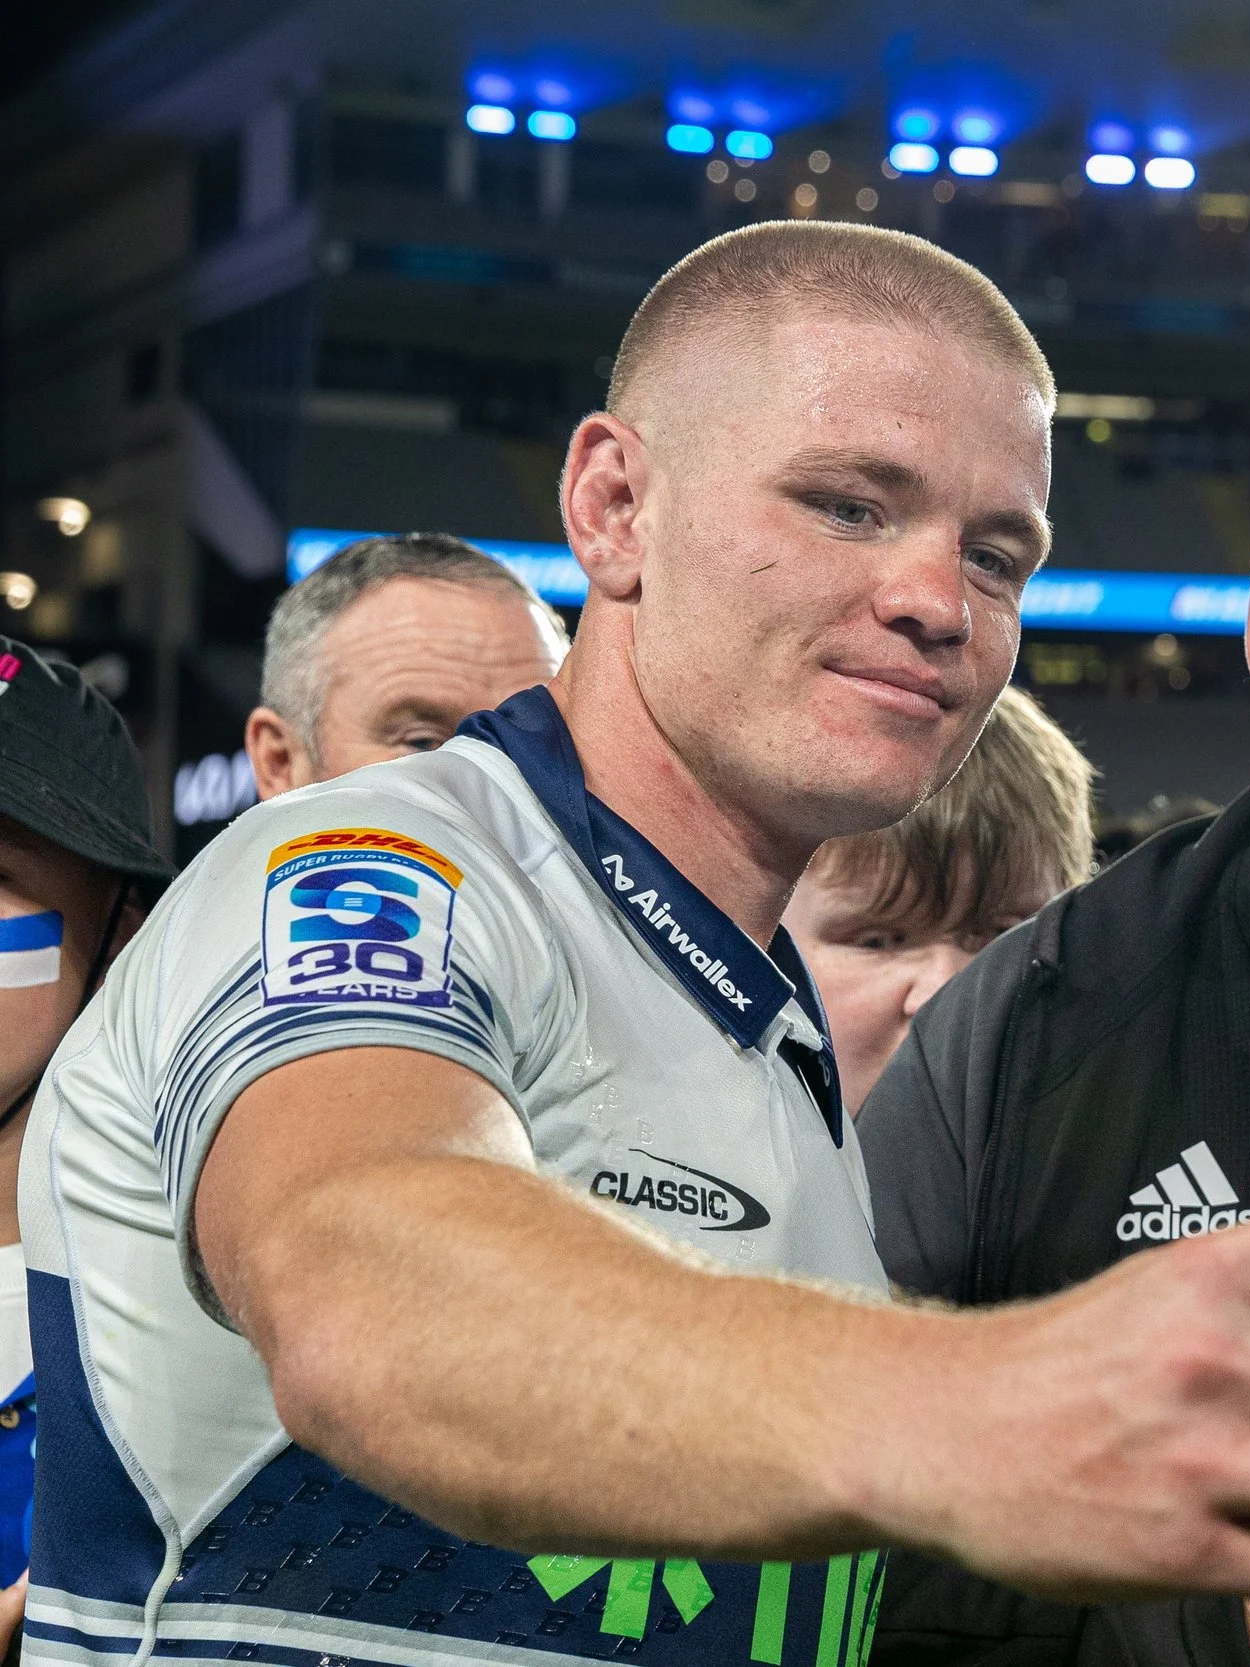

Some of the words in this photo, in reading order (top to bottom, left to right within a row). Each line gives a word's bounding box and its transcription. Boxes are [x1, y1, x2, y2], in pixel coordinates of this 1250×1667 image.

[305, 833, 430, 858] DHL
[274, 855, 327, 882] SUPER
[288, 942, 424, 986] 30
[628, 889, 753, 1012] Airwallex
[300, 983, 419, 1000] EARS
[589, 1171, 728, 1221] CLASSIC
